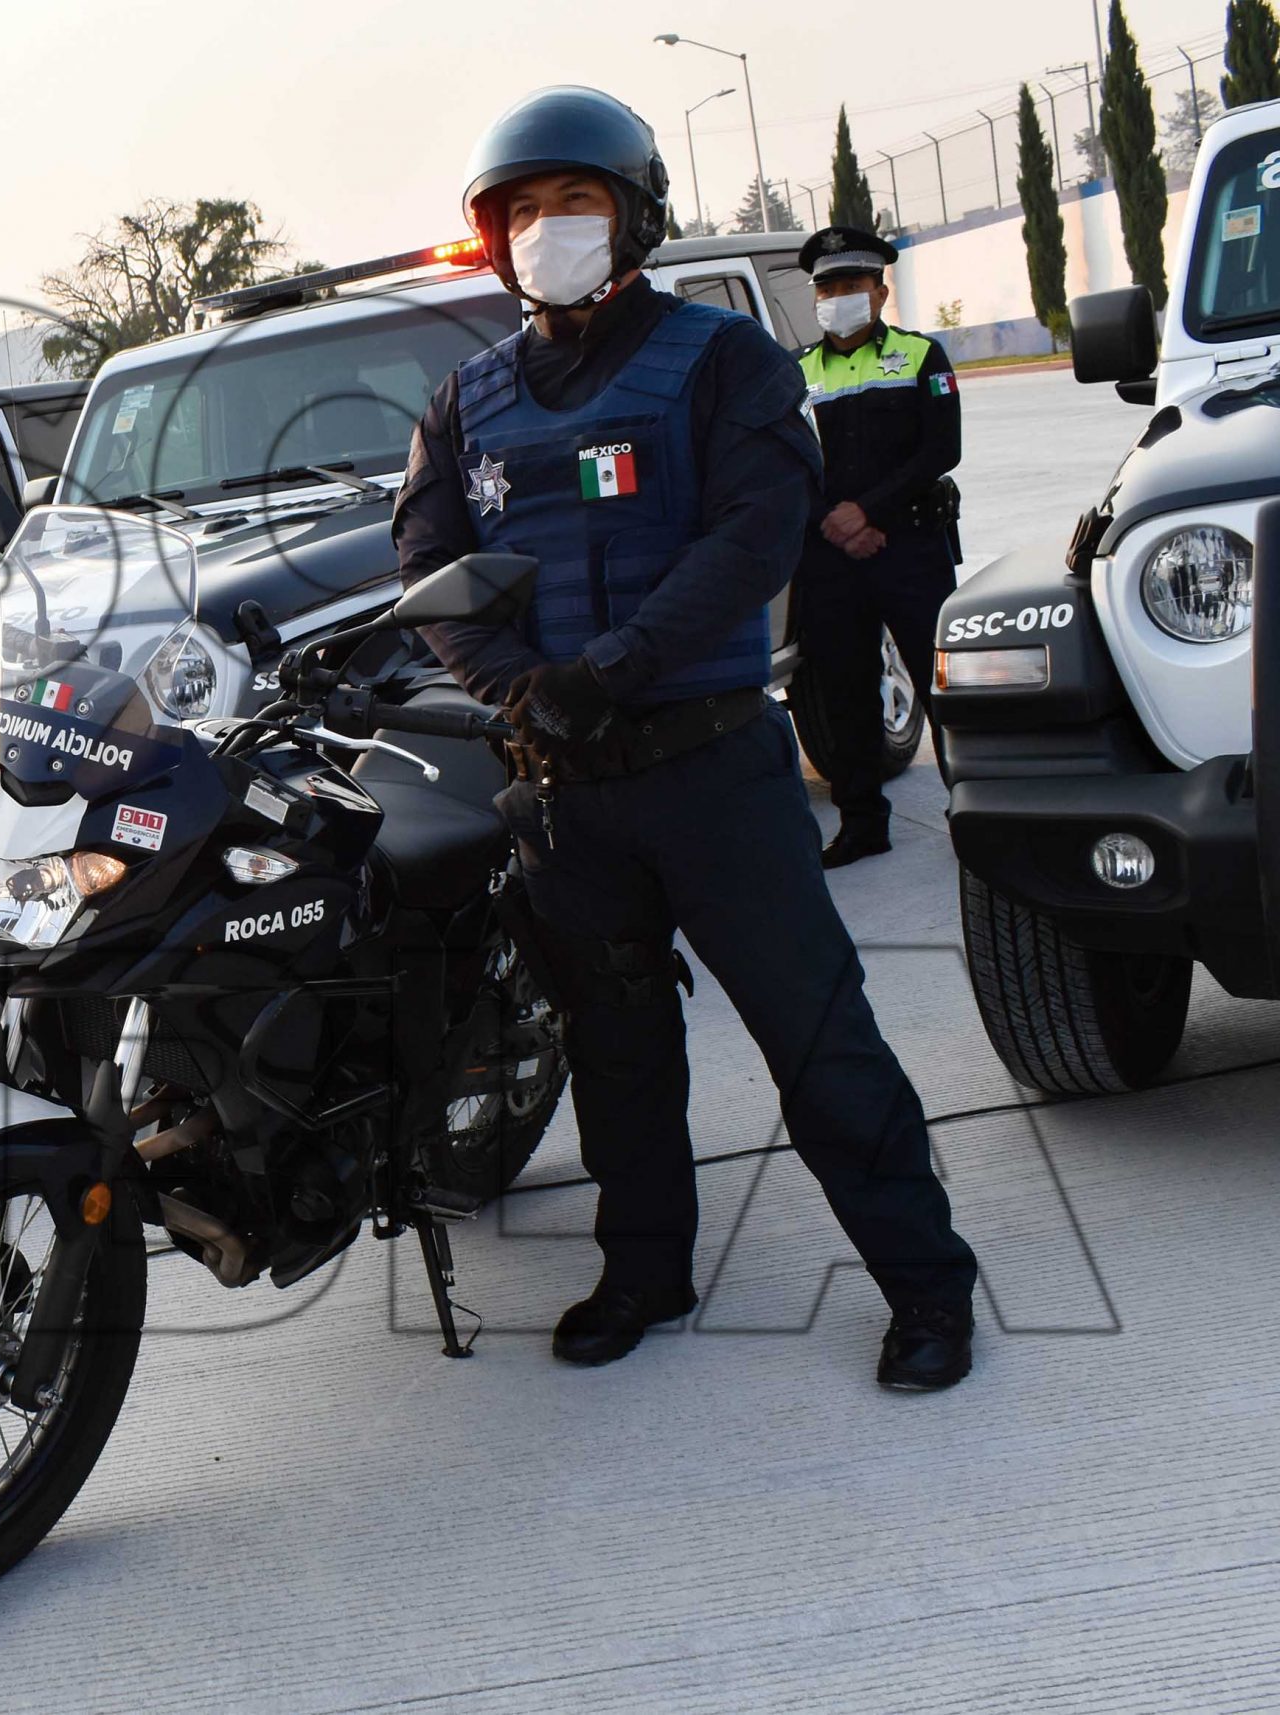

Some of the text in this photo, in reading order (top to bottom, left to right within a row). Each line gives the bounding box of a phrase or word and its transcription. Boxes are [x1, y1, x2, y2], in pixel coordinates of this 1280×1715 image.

[578, 442, 632, 461] MÉXICO
[945, 603, 1074, 643] SSC-010
[122, 810, 160, 827] 911
[116, 825, 160, 840] EMERGENCIAS
[224, 899, 325, 942] ROCA 055
